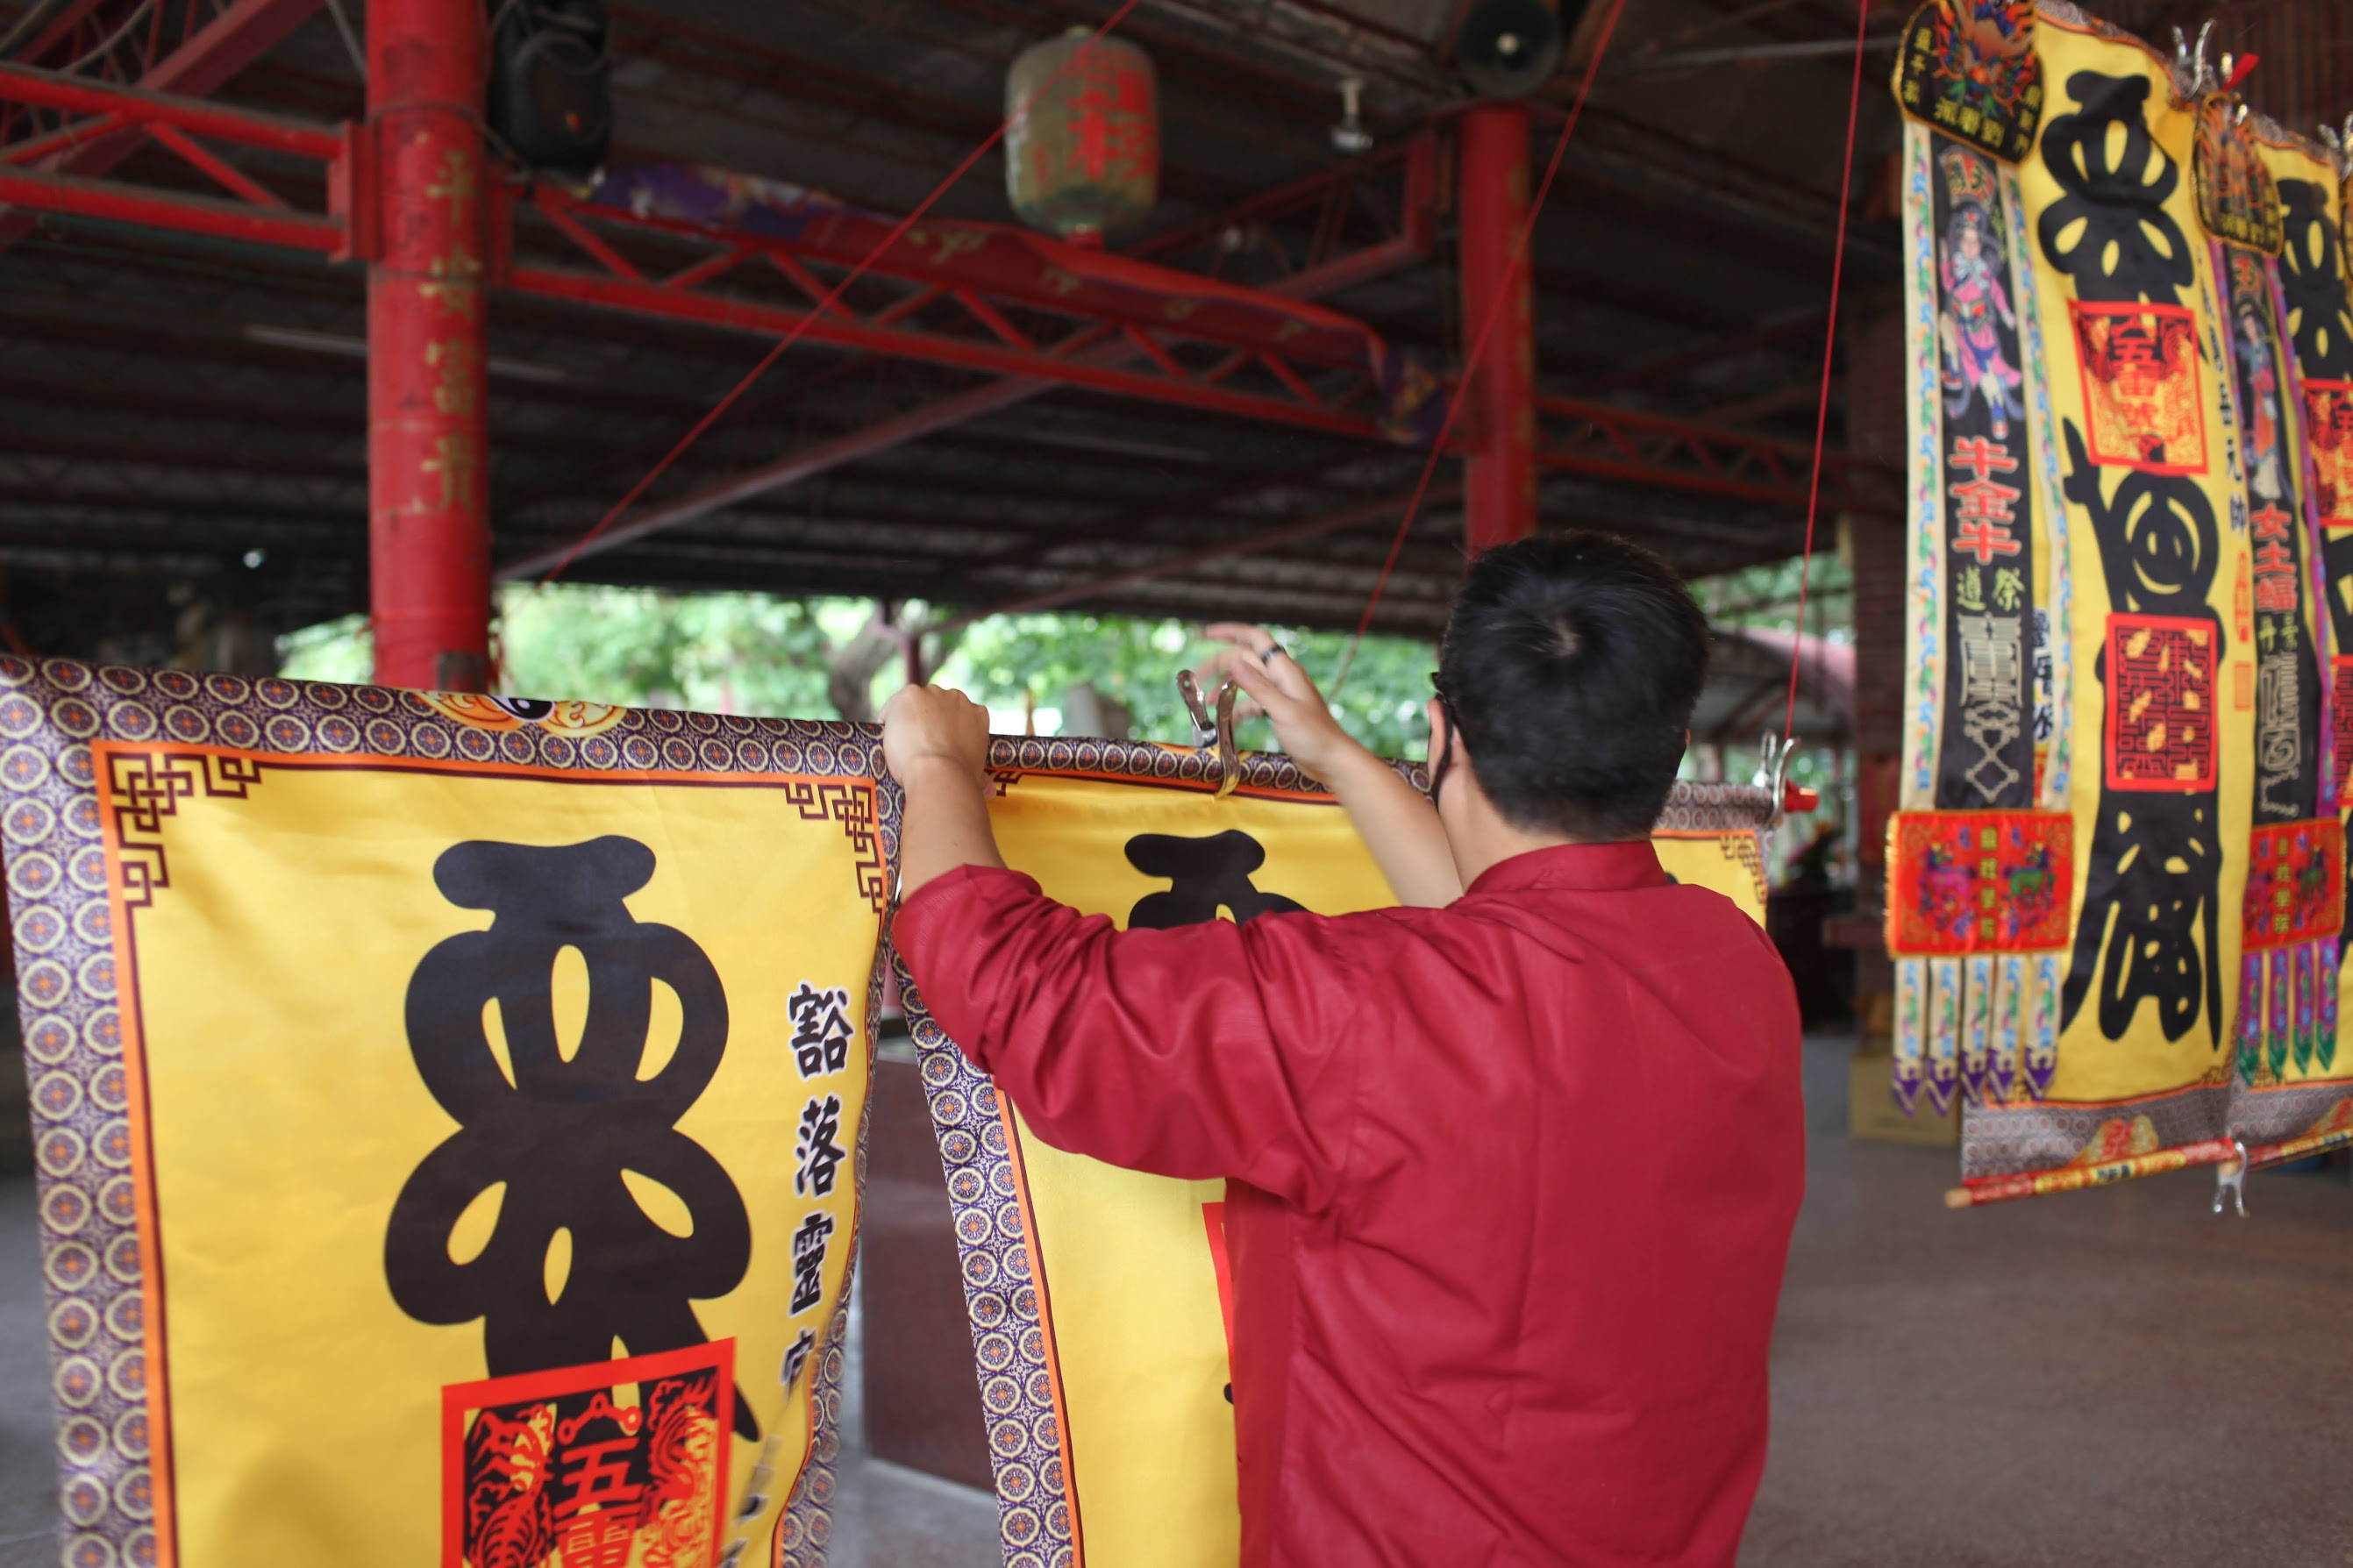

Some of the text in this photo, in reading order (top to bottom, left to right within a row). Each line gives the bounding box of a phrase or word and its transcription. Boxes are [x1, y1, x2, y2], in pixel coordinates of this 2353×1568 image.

[420, 150, 480, 510] 平安富貴
[1949, 435, 2021, 565] 牛金牛
[2250, 502, 2298, 612] 女土蝠
